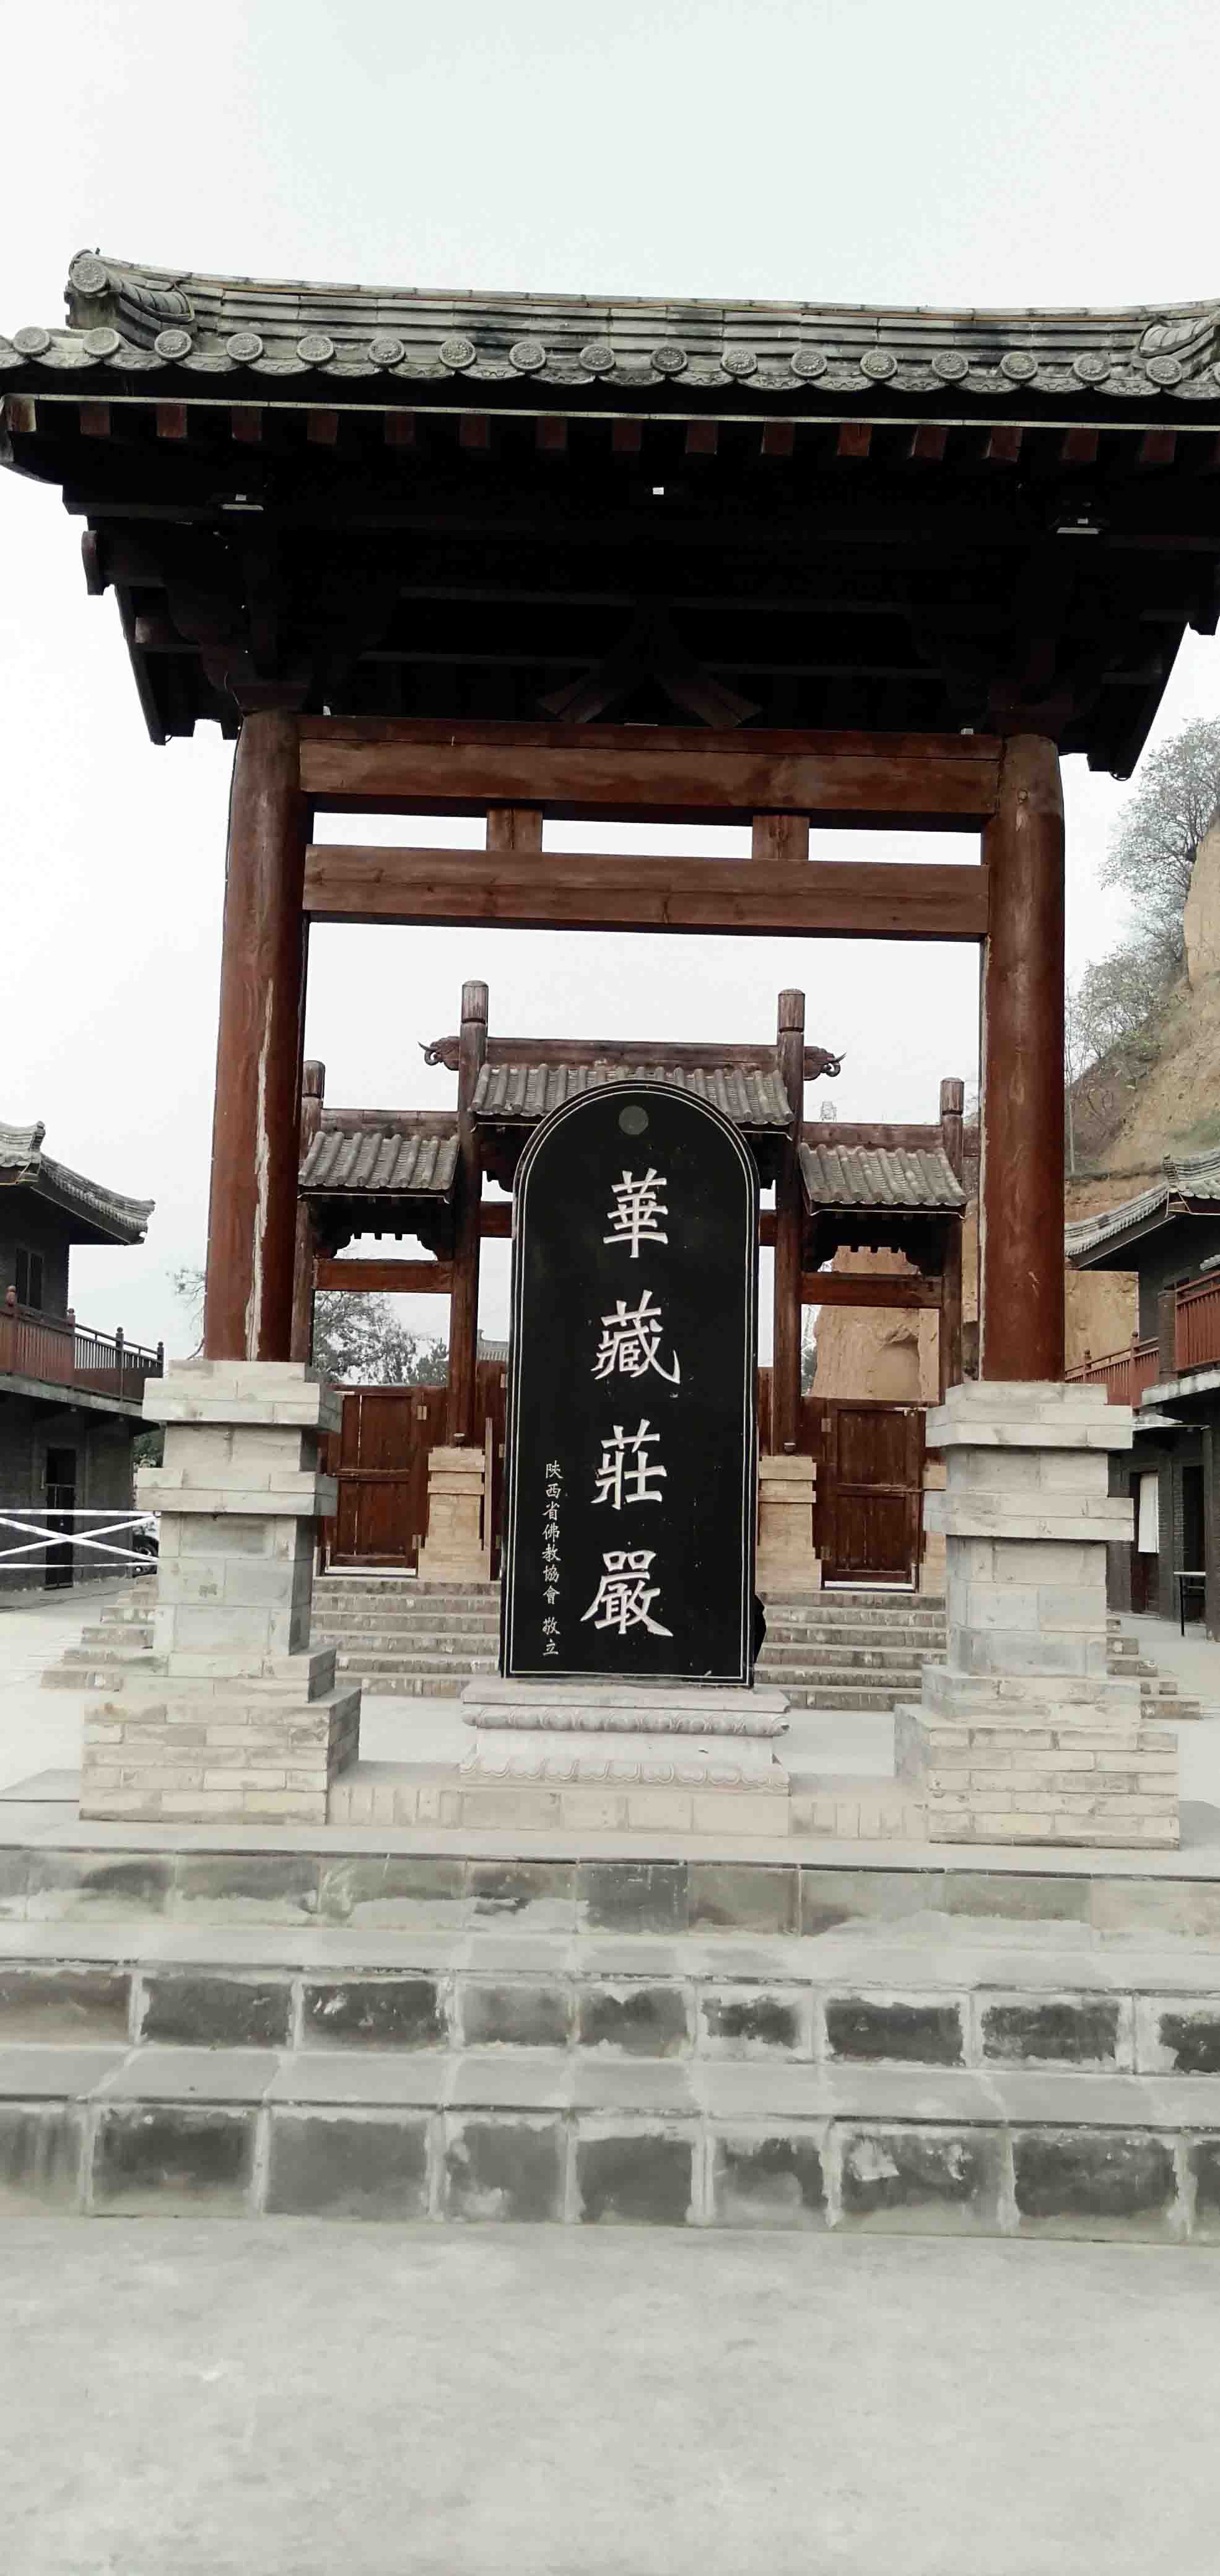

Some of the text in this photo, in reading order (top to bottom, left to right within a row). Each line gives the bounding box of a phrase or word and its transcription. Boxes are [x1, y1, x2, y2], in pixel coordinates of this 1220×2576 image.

[580, 1168, 681, 1637] 華藏莊嚴
[542, 1616, 560, 1656] 敬立
